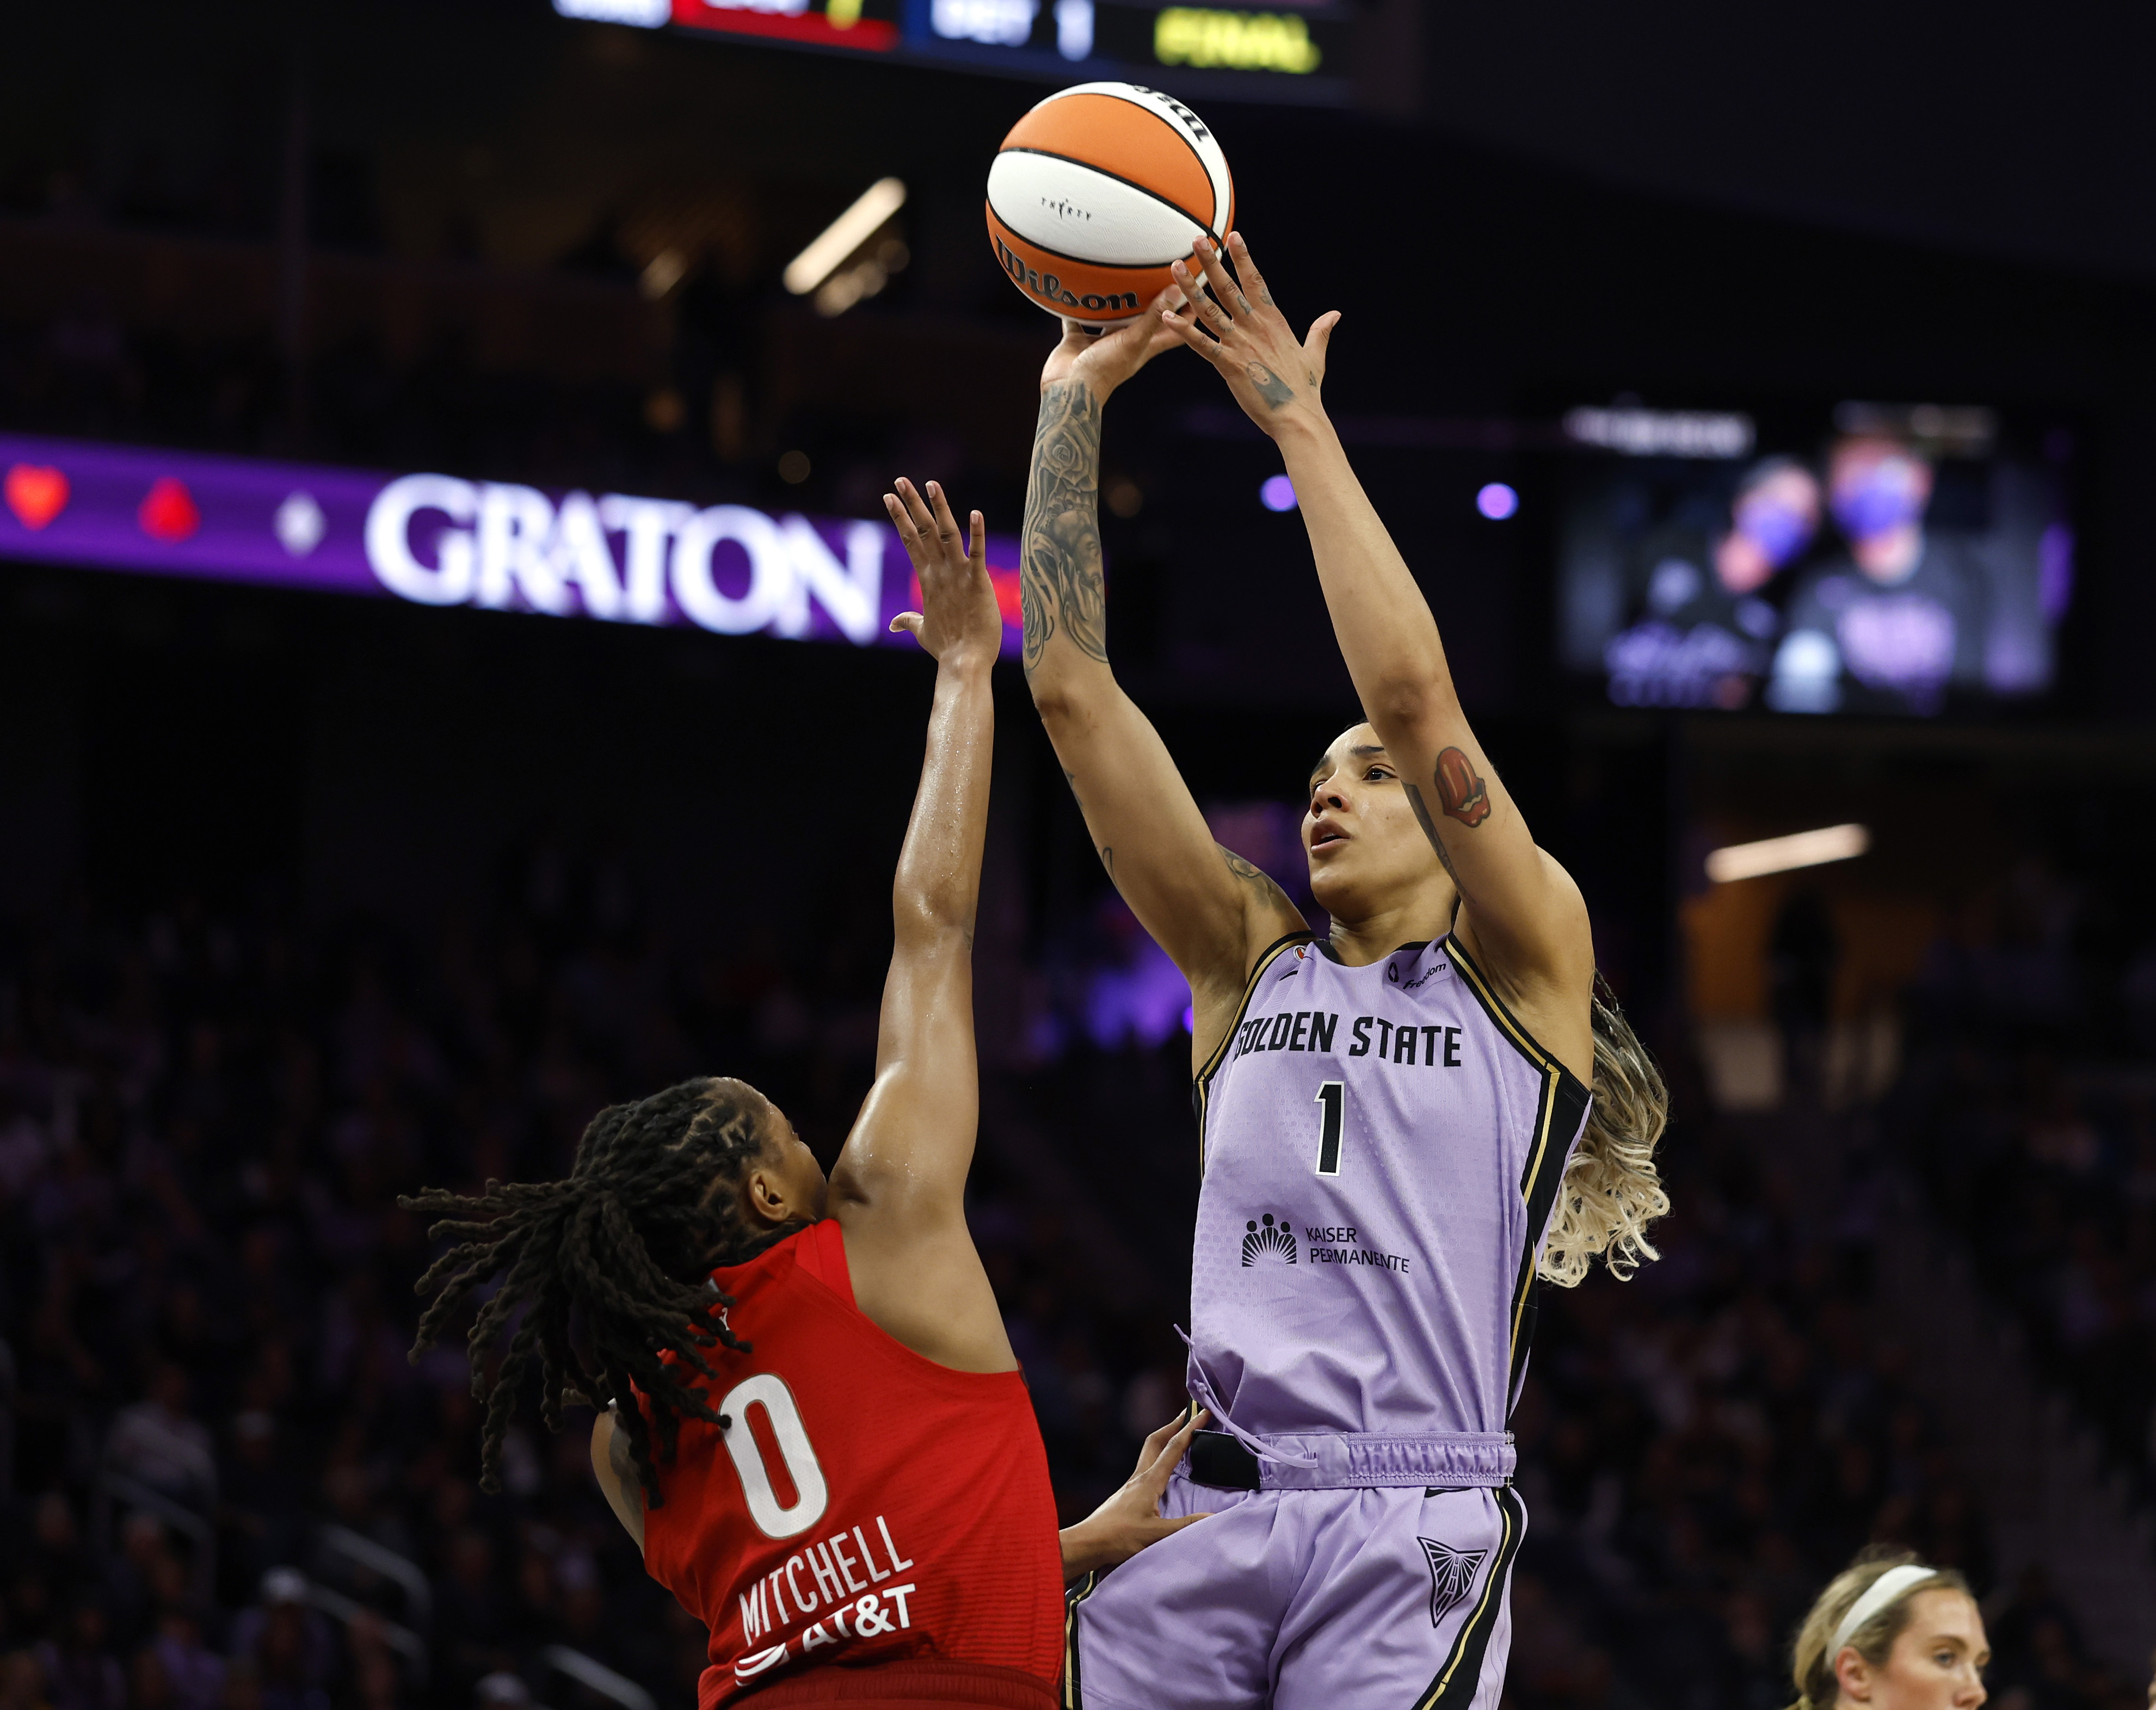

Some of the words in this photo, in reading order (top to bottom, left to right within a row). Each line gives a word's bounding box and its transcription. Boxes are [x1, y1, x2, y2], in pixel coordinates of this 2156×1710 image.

[1155, 7, 1321, 74] FINAL
[995, 233, 1141, 311] Wilson
[364, 472, 885, 646] GRATON
[1233, 1011, 1339, 1063] GOLDEN
[1348, 1016, 1462, 1067] STATE
[1313, 1081, 1346, 1177] 1
[1306, 1227, 1357, 1243] KAISER
[1310, 1248, 1410, 1274] PERMANENTE
[718, 1372, 829, 1540] 0
[738, 1515, 914, 1646] MITCHELL
[802, 1583, 916, 1653] AT&T
